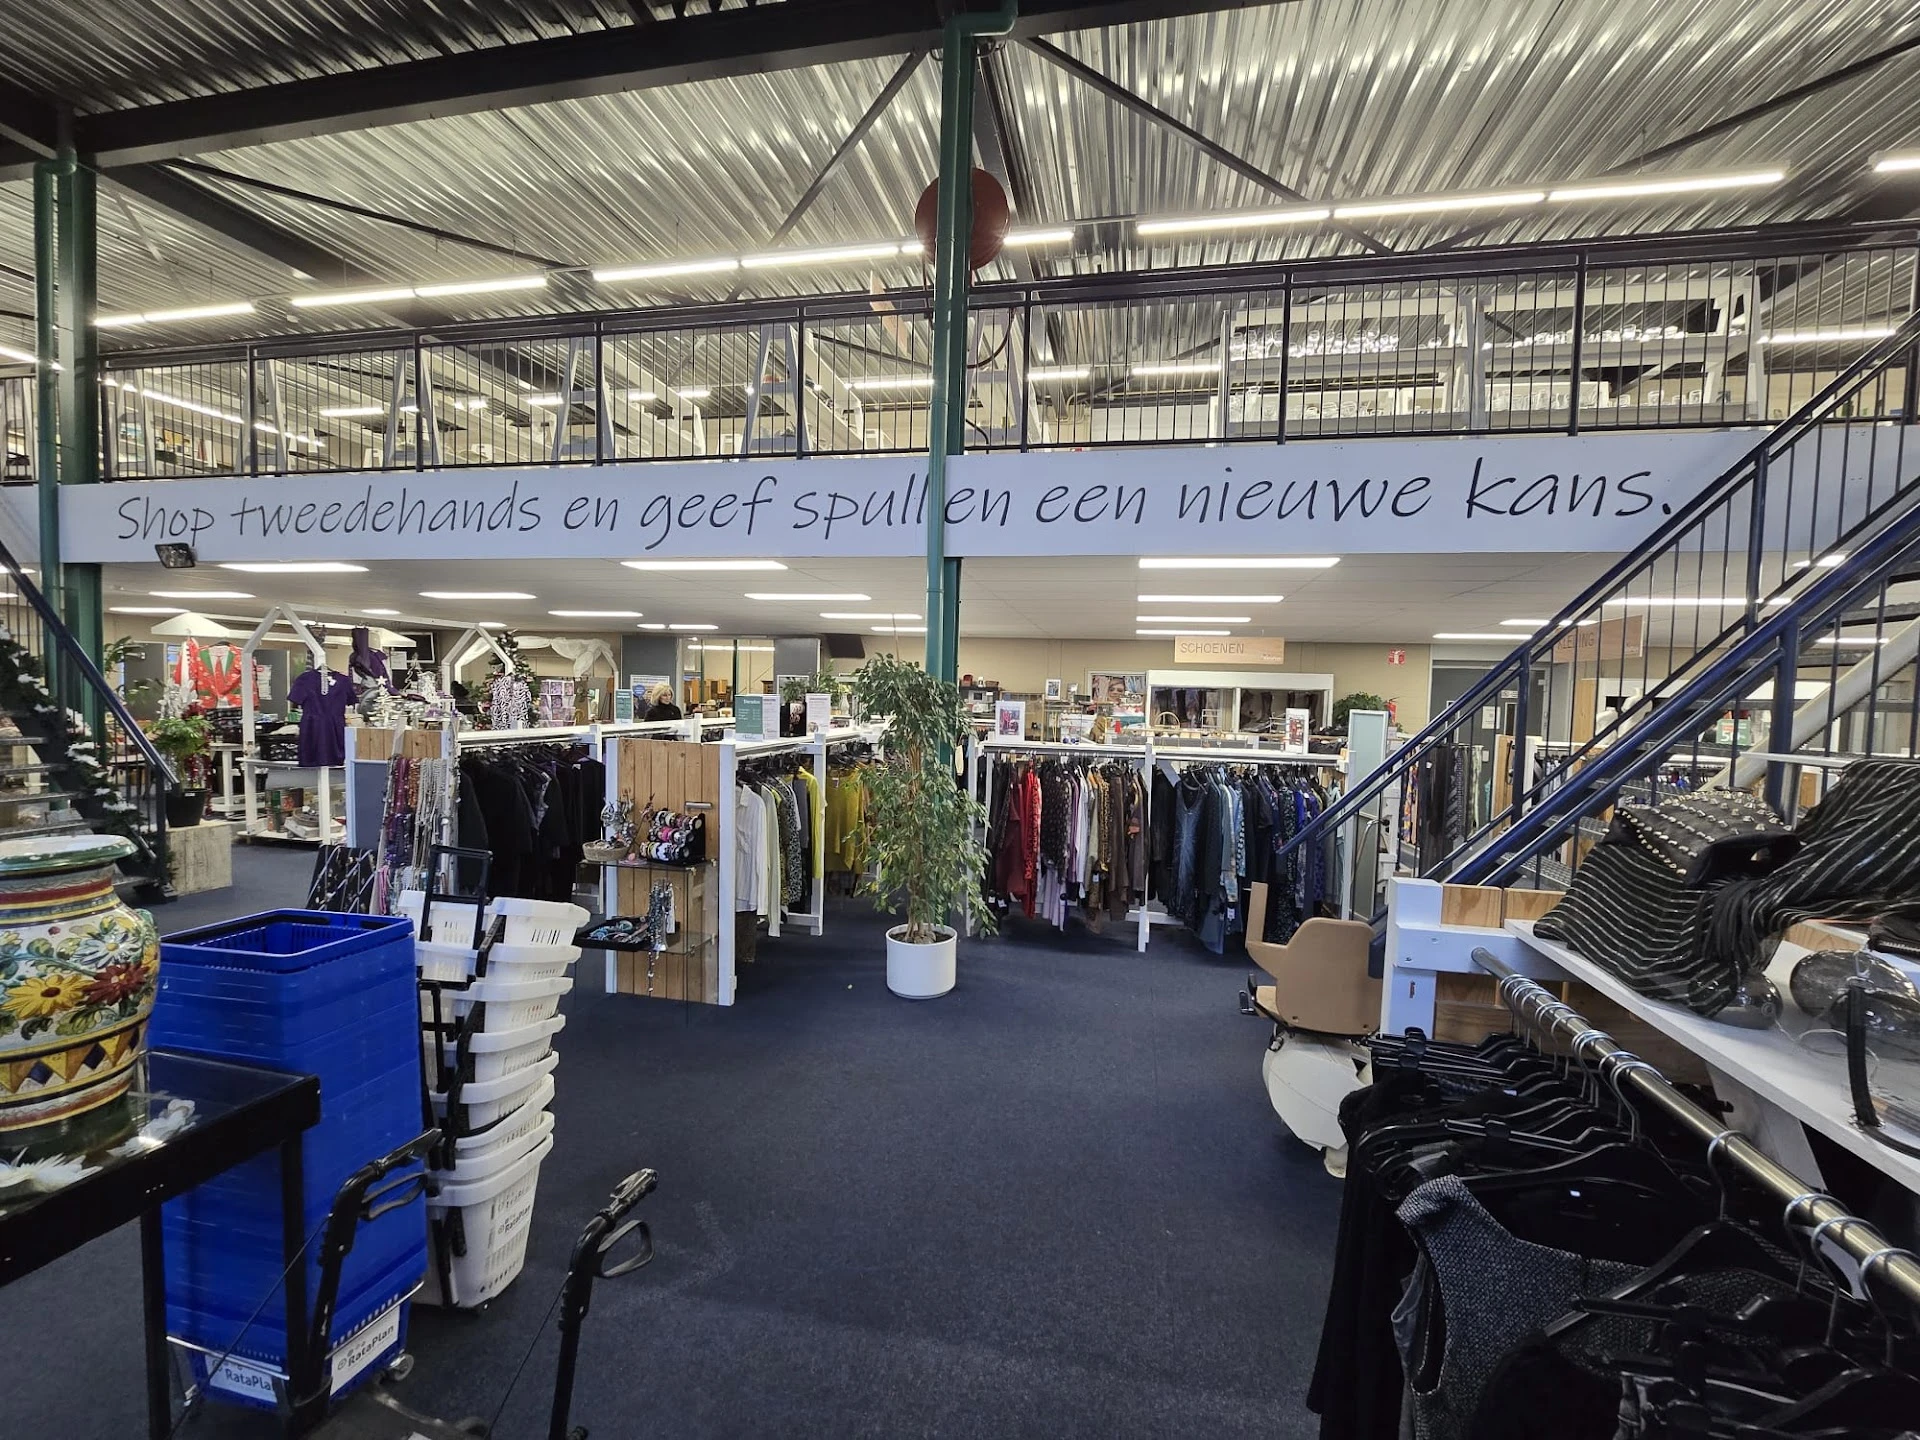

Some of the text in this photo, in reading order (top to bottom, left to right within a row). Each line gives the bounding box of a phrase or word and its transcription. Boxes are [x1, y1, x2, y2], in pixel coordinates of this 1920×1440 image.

[118, 457, 1672, 551] Shop tweedehands en geef spullen een nieuwe kans.
[1180, 642, 1245, 654] SCHOENEN
[348, 1325, 394, 1366] RataPlan
[226, 1368, 272, 1391] RataPla
